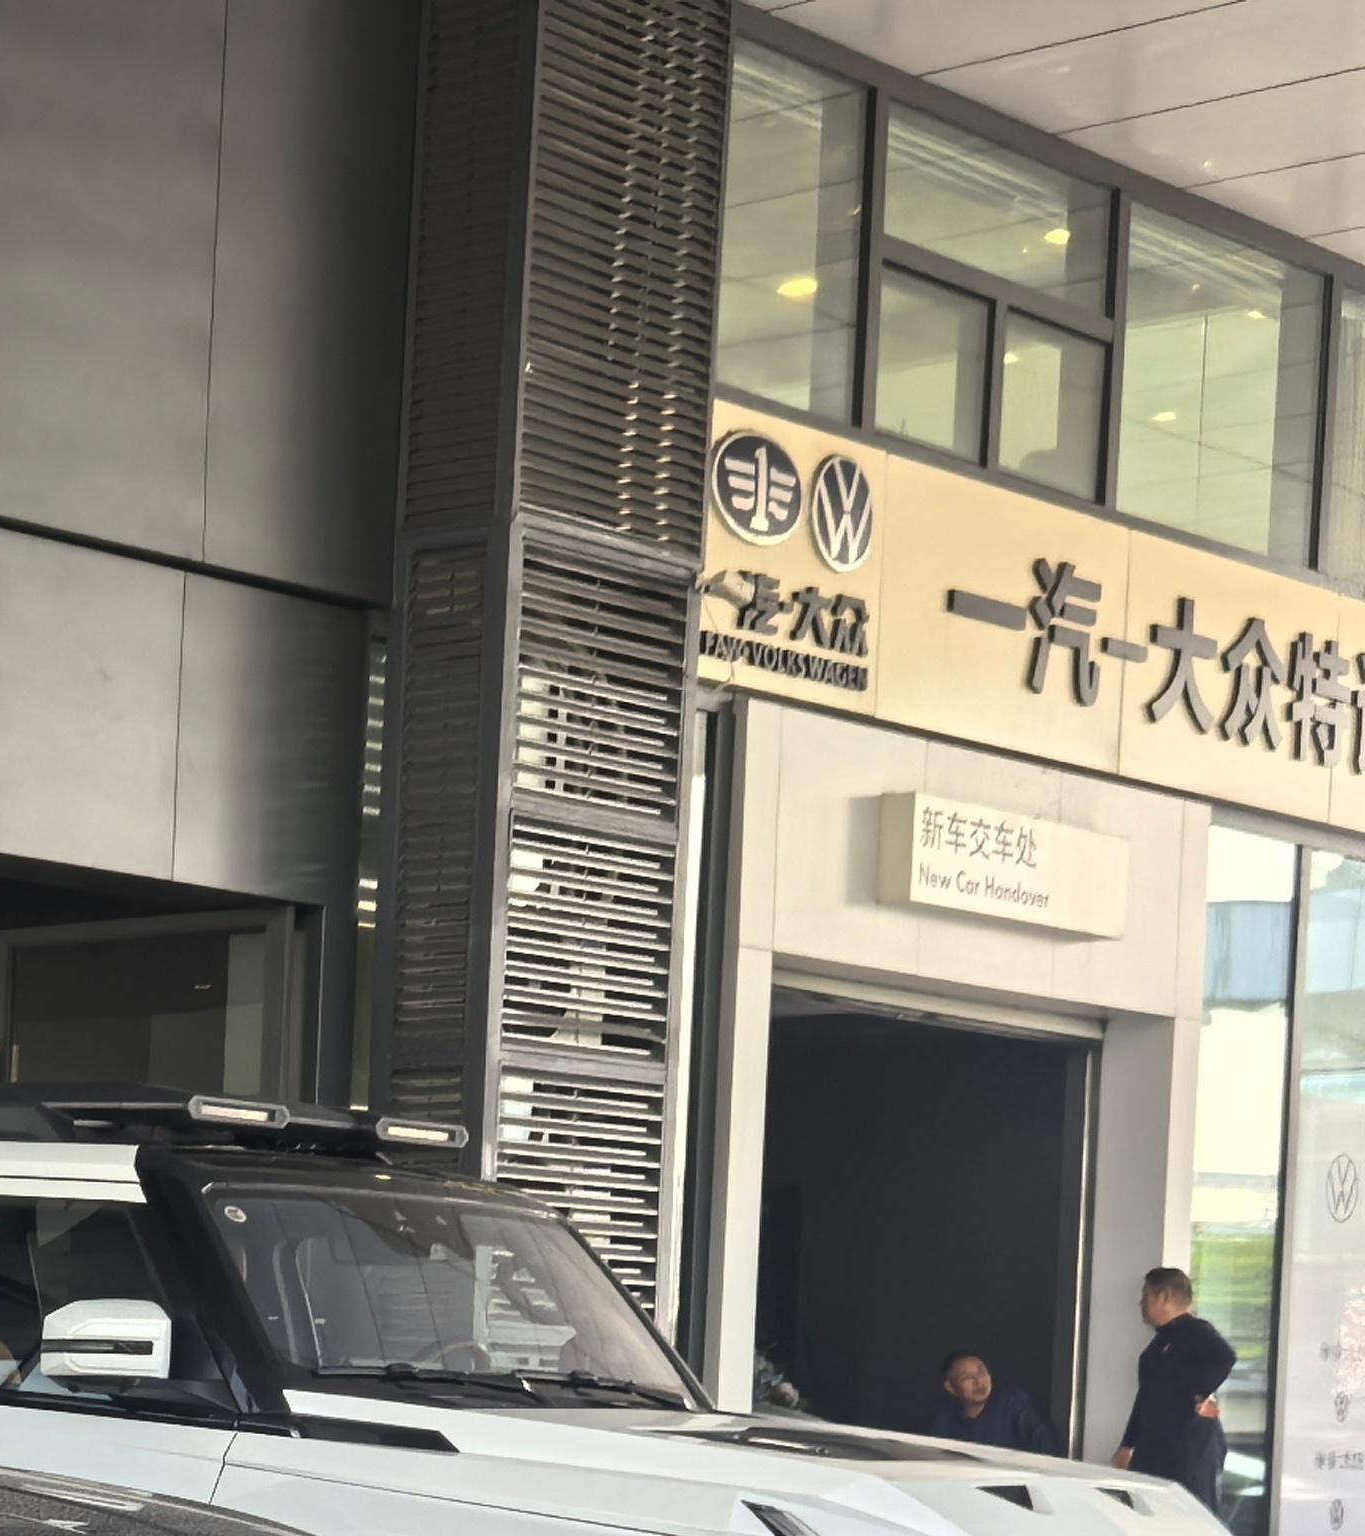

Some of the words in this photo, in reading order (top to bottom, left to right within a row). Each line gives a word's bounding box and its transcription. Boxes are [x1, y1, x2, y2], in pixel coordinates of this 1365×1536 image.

[946, 557, 1365, 777] 一汽-大众特
[920, 806, 1038, 869] 新车交车处
[918, 862, 952, 889] New
[956, 870, 980, 895] Car
[984, 875, 1050, 908] Handover
